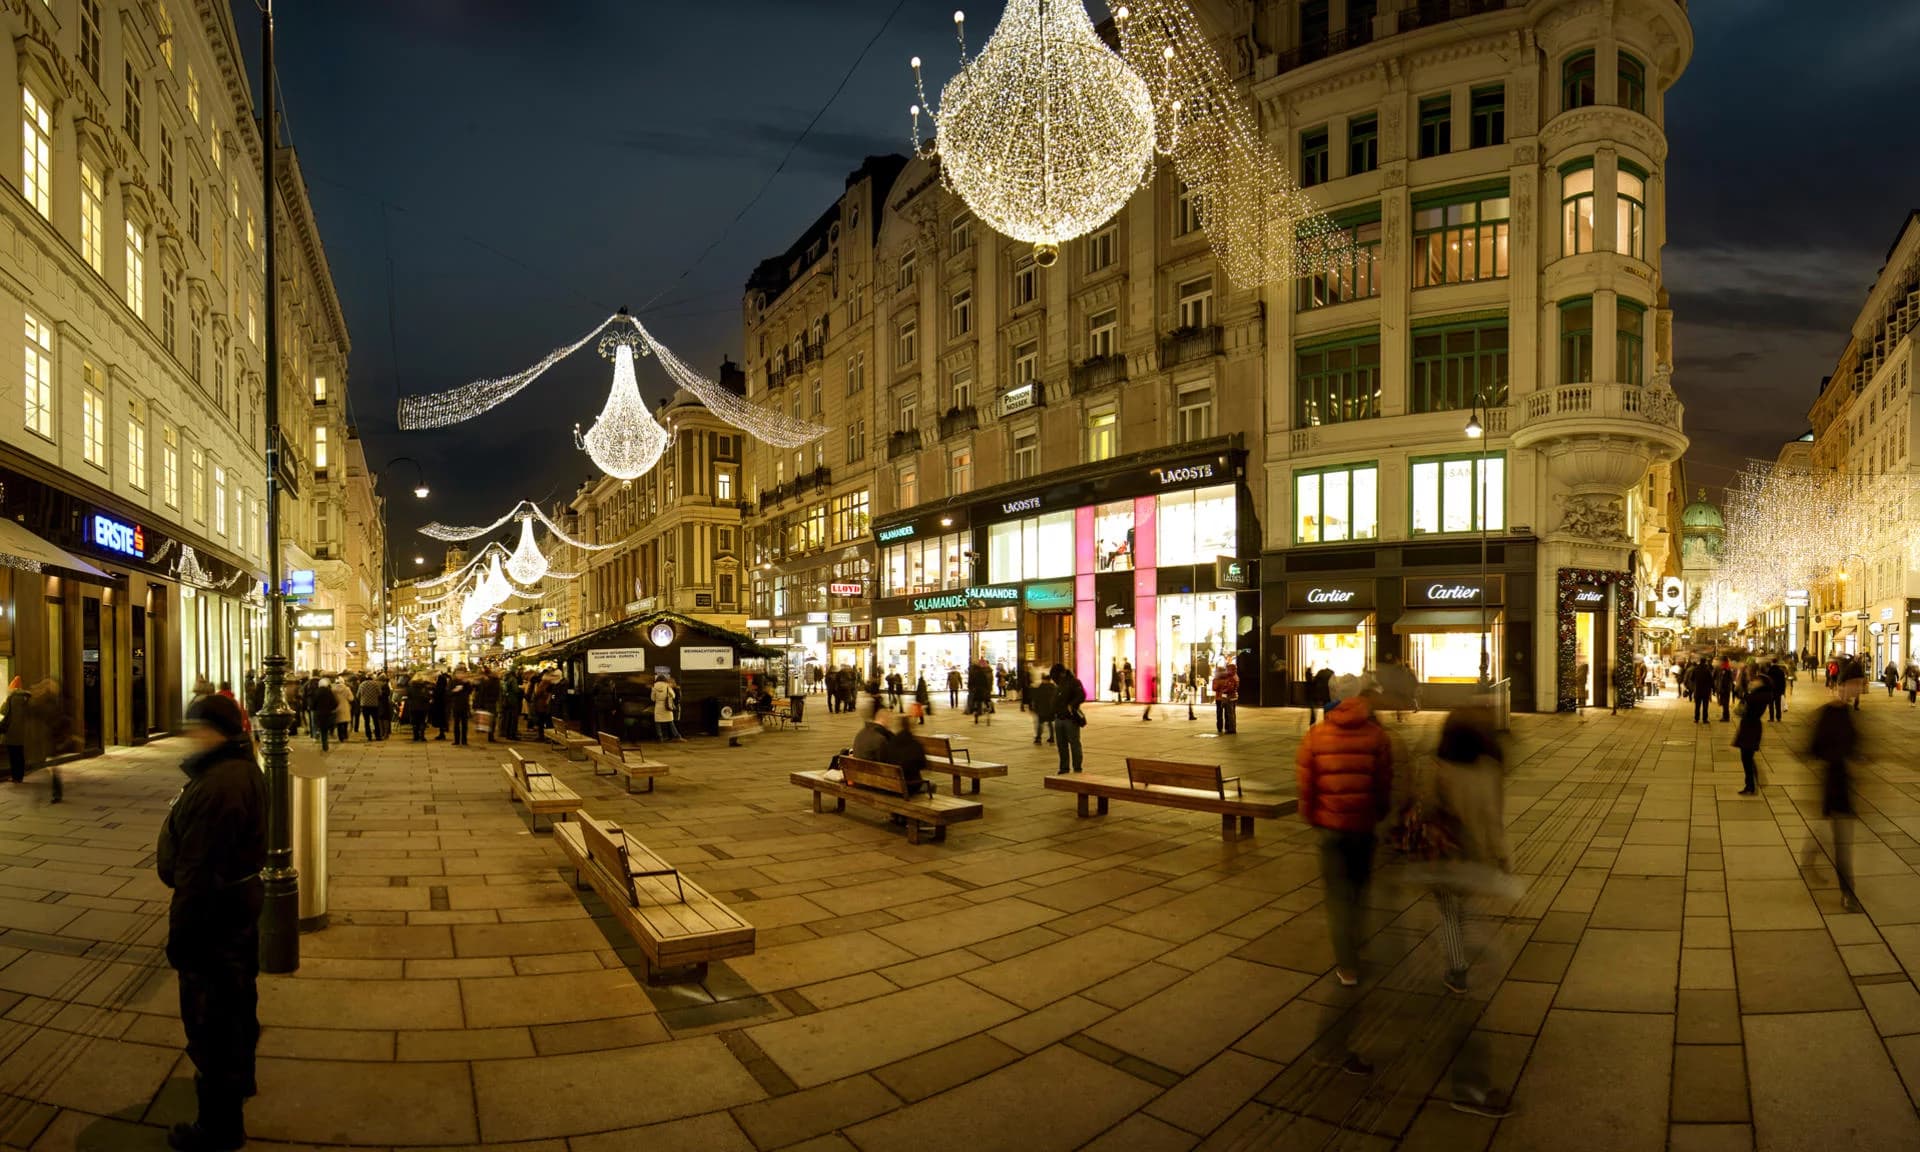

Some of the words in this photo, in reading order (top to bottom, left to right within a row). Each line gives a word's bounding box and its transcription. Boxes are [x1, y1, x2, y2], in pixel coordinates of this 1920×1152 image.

[1160, 464, 1212, 484] LACOSTE
[1003, 497, 1040, 513] LACOSTE
[95, 515, 134, 555] ERSTE
[880, 526, 914, 541] SALAMANDER
[832, 585, 860, 593] LLOYD
[965, 588, 1017, 599] SALAMANDER
[1308, 588, 1354, 603] Cartier
[1428, 584, 1480, 599] Cartier
[914, 595, 968, 611] SALAMANDER
